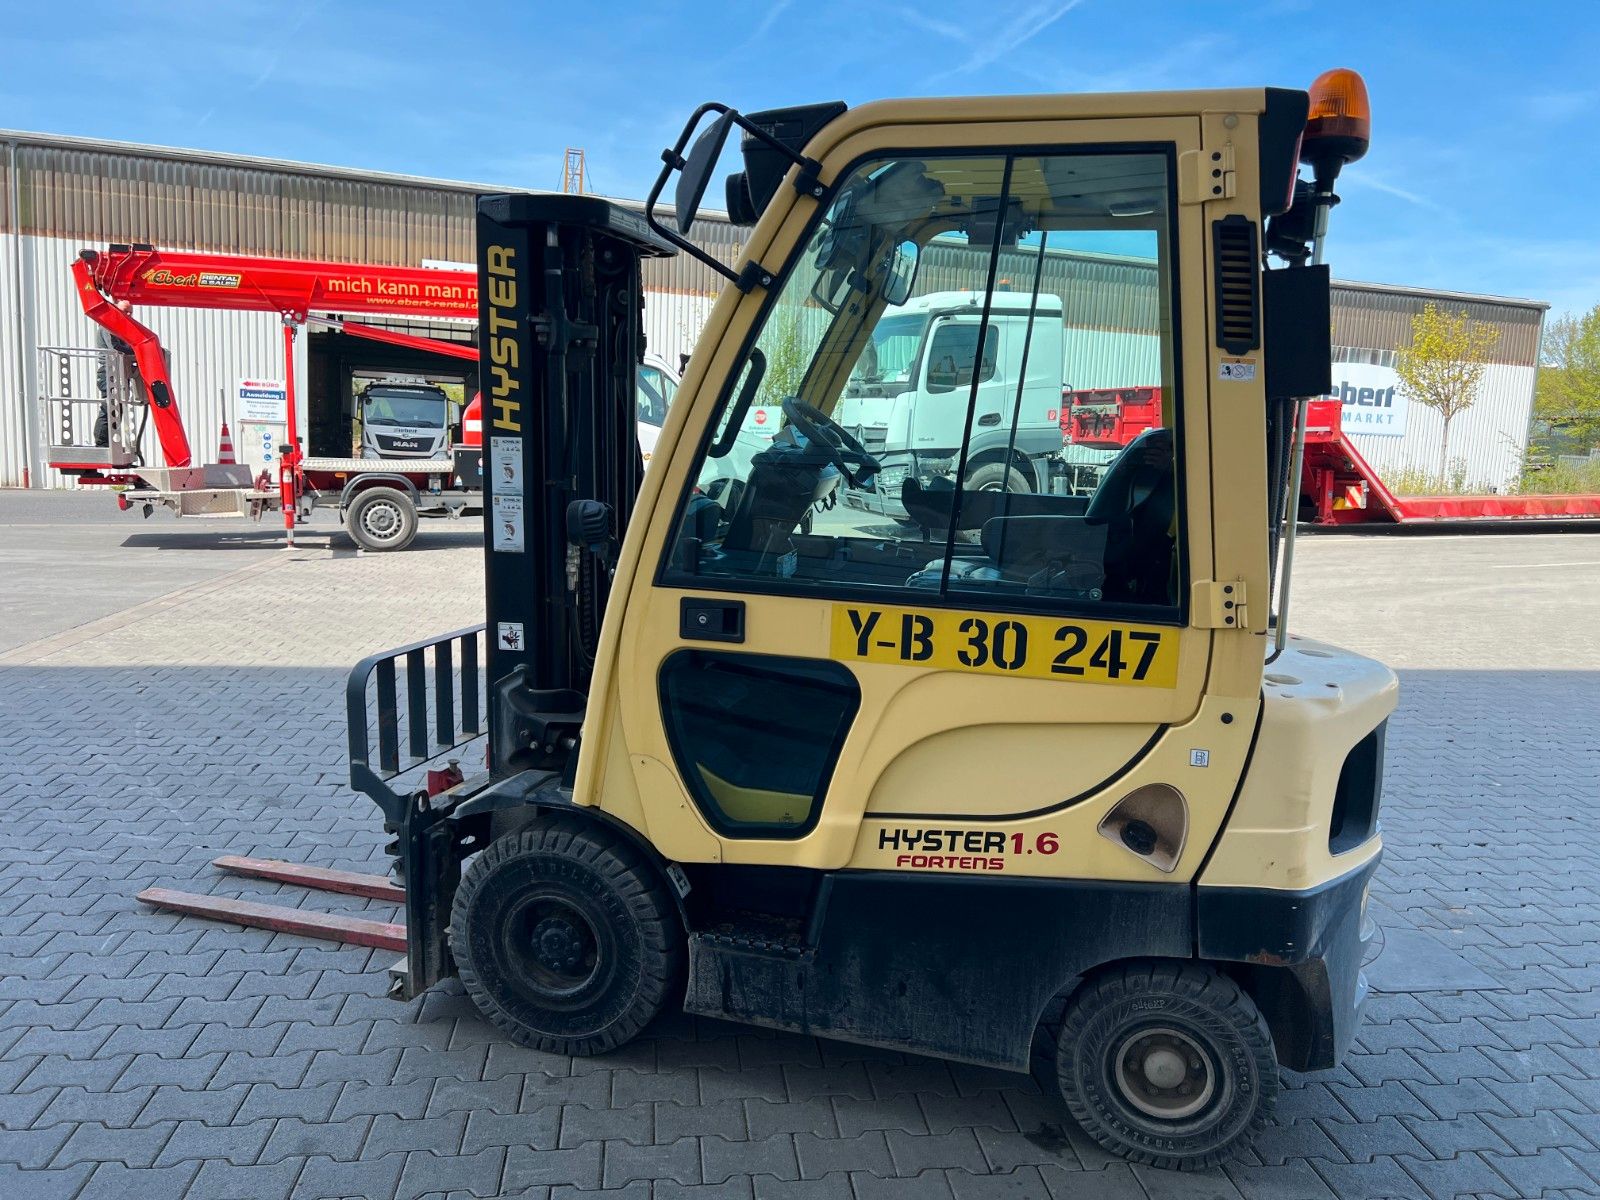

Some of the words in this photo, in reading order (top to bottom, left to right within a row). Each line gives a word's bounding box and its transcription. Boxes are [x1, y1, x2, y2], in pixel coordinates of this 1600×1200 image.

[153, 269, 197, 287] Ebert
[328, 277, 372, 294] mich
[377, 278, 419, 296] kann
[425, 284, 462, 299] man
[487, 244, 521, 432] HYSTER
[1341, 412, 1394, 424] MARKT
[847, 609, 935, 661] Y-B
[957, 617, 1028, 670] 30
[1051, 625, 1161, 681] 247
[878, 828, 1006, 853] HYSTER
[1010, 832, 1060, 855] 1.6
[896, 855, 1005, 871] FORTENS
